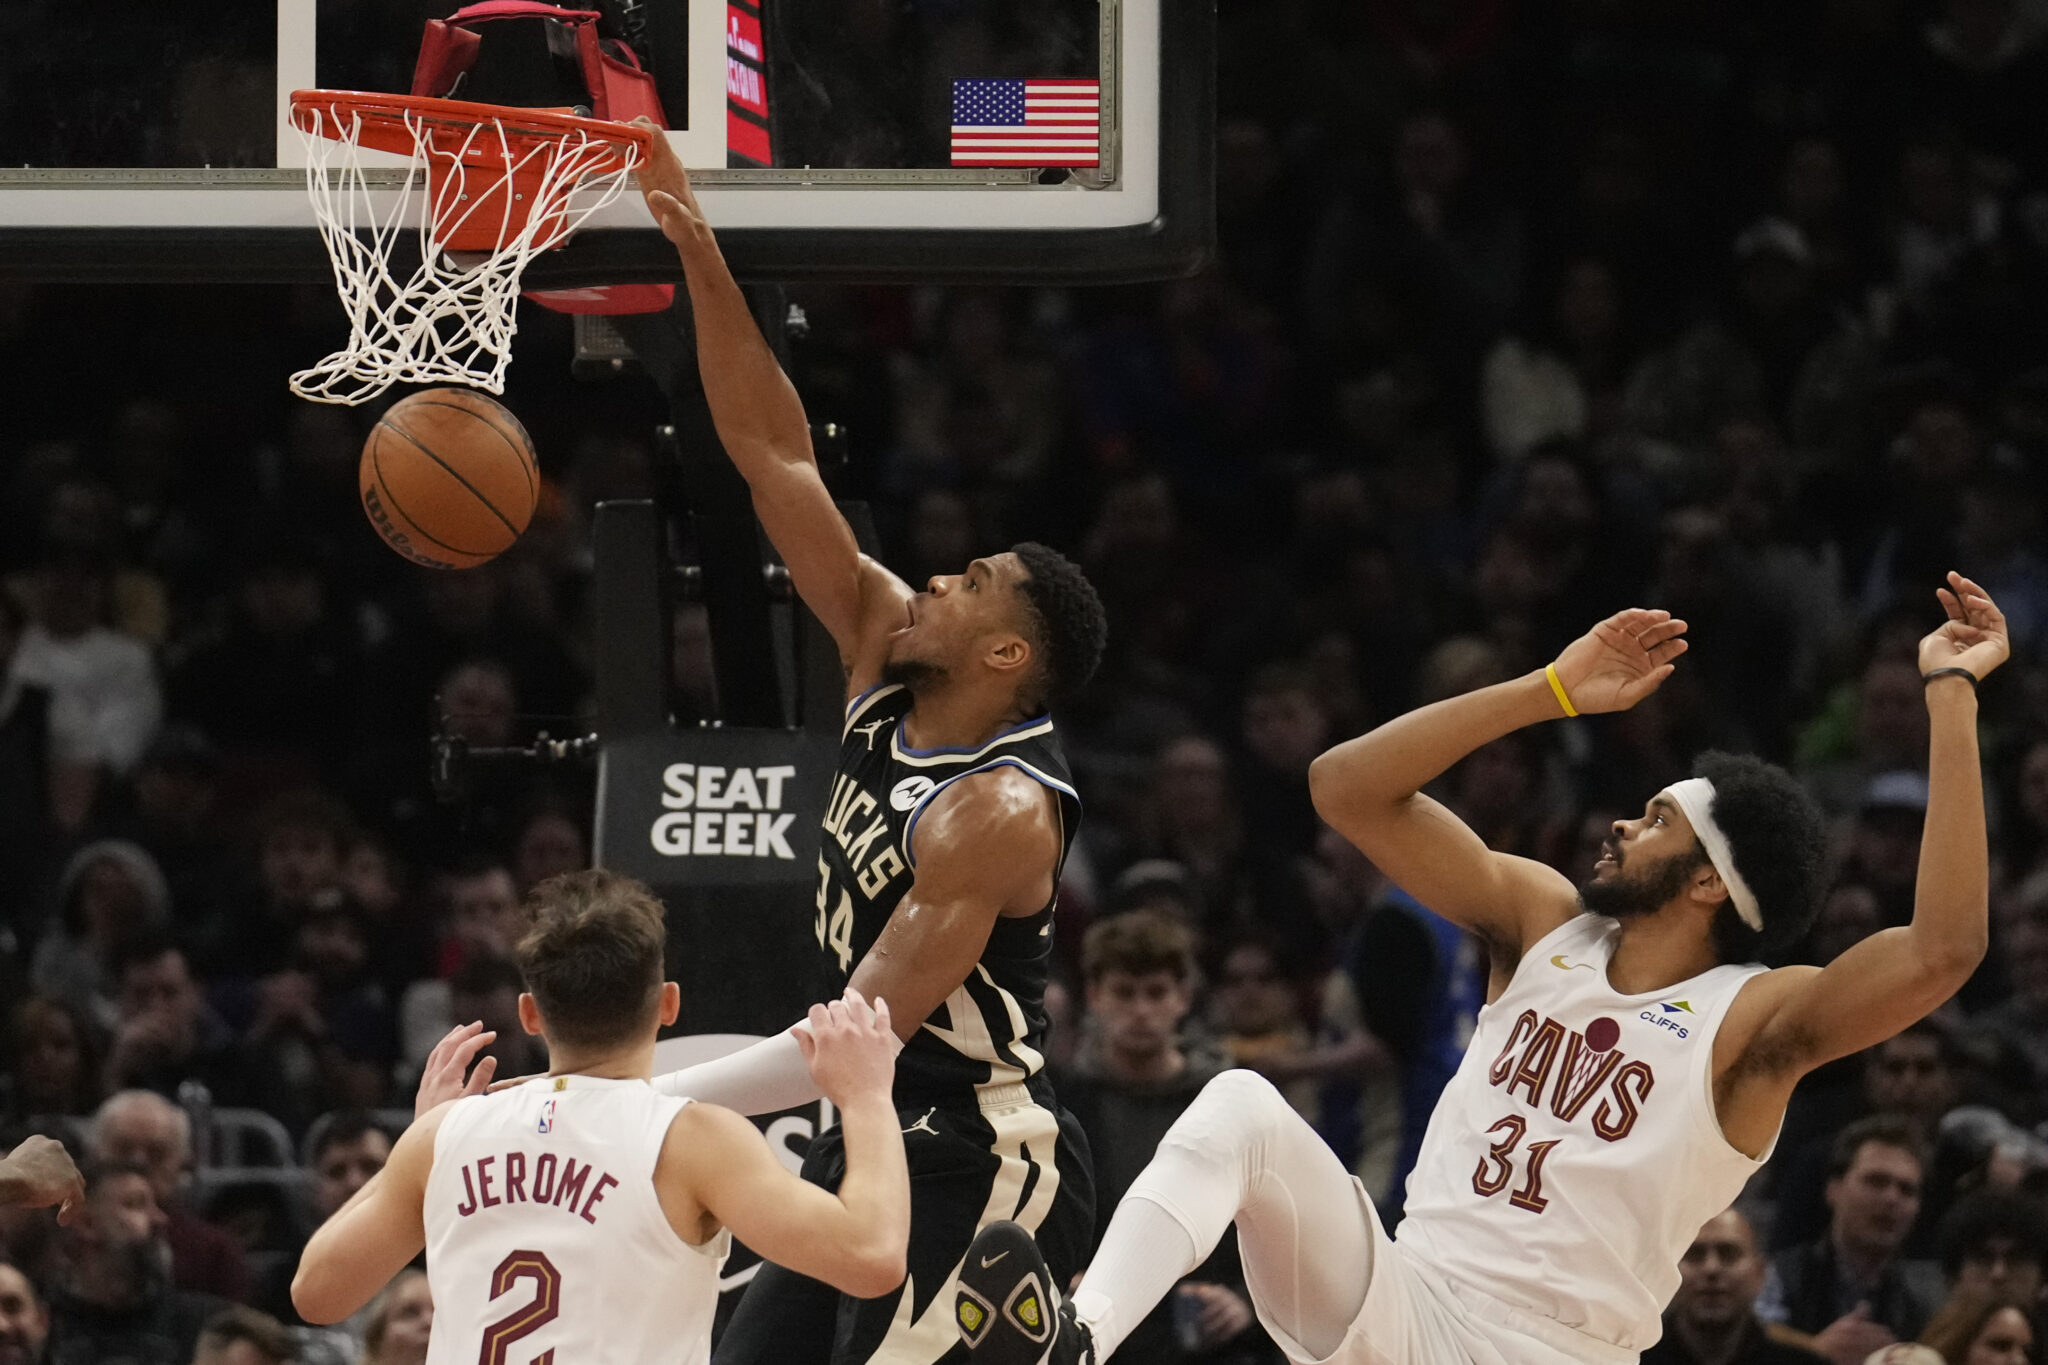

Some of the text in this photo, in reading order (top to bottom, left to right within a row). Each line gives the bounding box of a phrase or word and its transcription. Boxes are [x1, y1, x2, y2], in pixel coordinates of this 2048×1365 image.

[650, 811, 796, 860] GEEK
[661, 763, 796, 811] SEAT
[822, 769, 905, 901] UCKS
[815, 847, 854, 976] 34
[1488, 1008, 1656, 1143] CAVS
[1639, 1010, 1690, 1040] CLIFFS
[457, 1151, 620, 1225] JEROME
[1471, 1113, 1564, 1215] 31
[478, 1249, 562, 1365] 2
